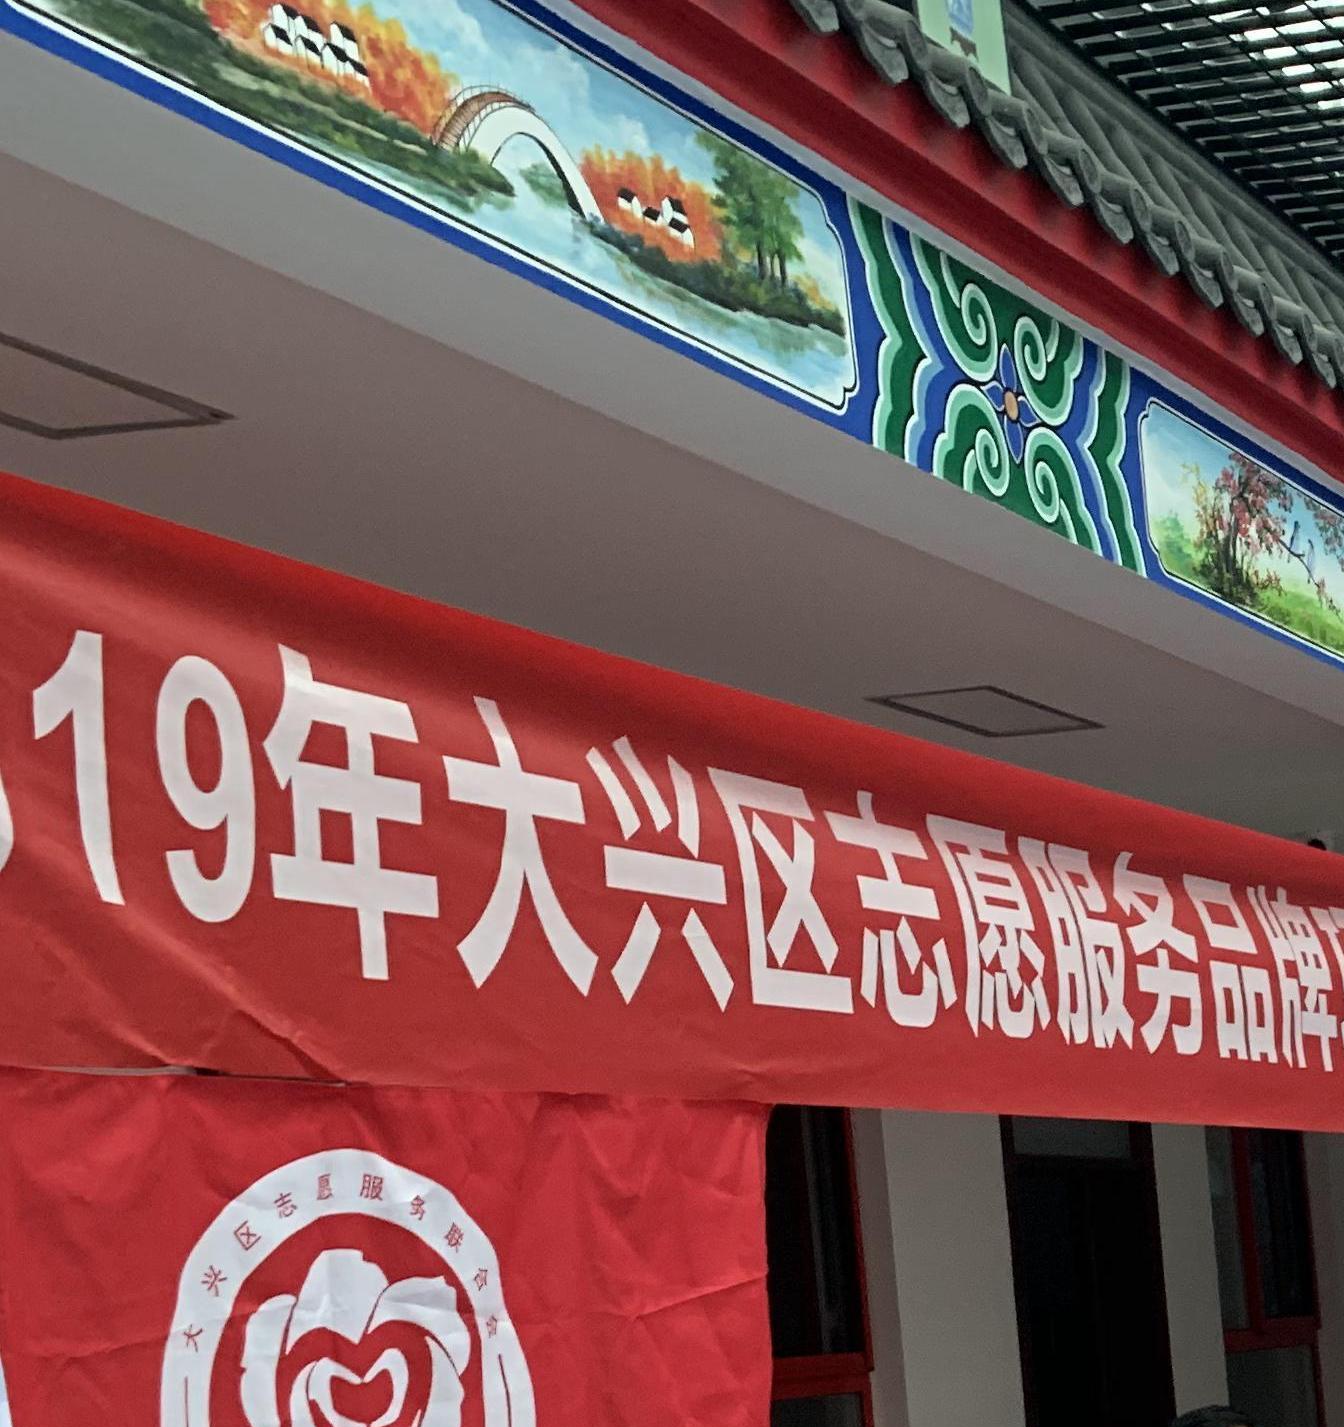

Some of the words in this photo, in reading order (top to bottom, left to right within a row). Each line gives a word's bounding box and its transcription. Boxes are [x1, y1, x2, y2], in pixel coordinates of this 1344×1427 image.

[183, 1172, 498, 1353] 大兴区志愿服务联合会
